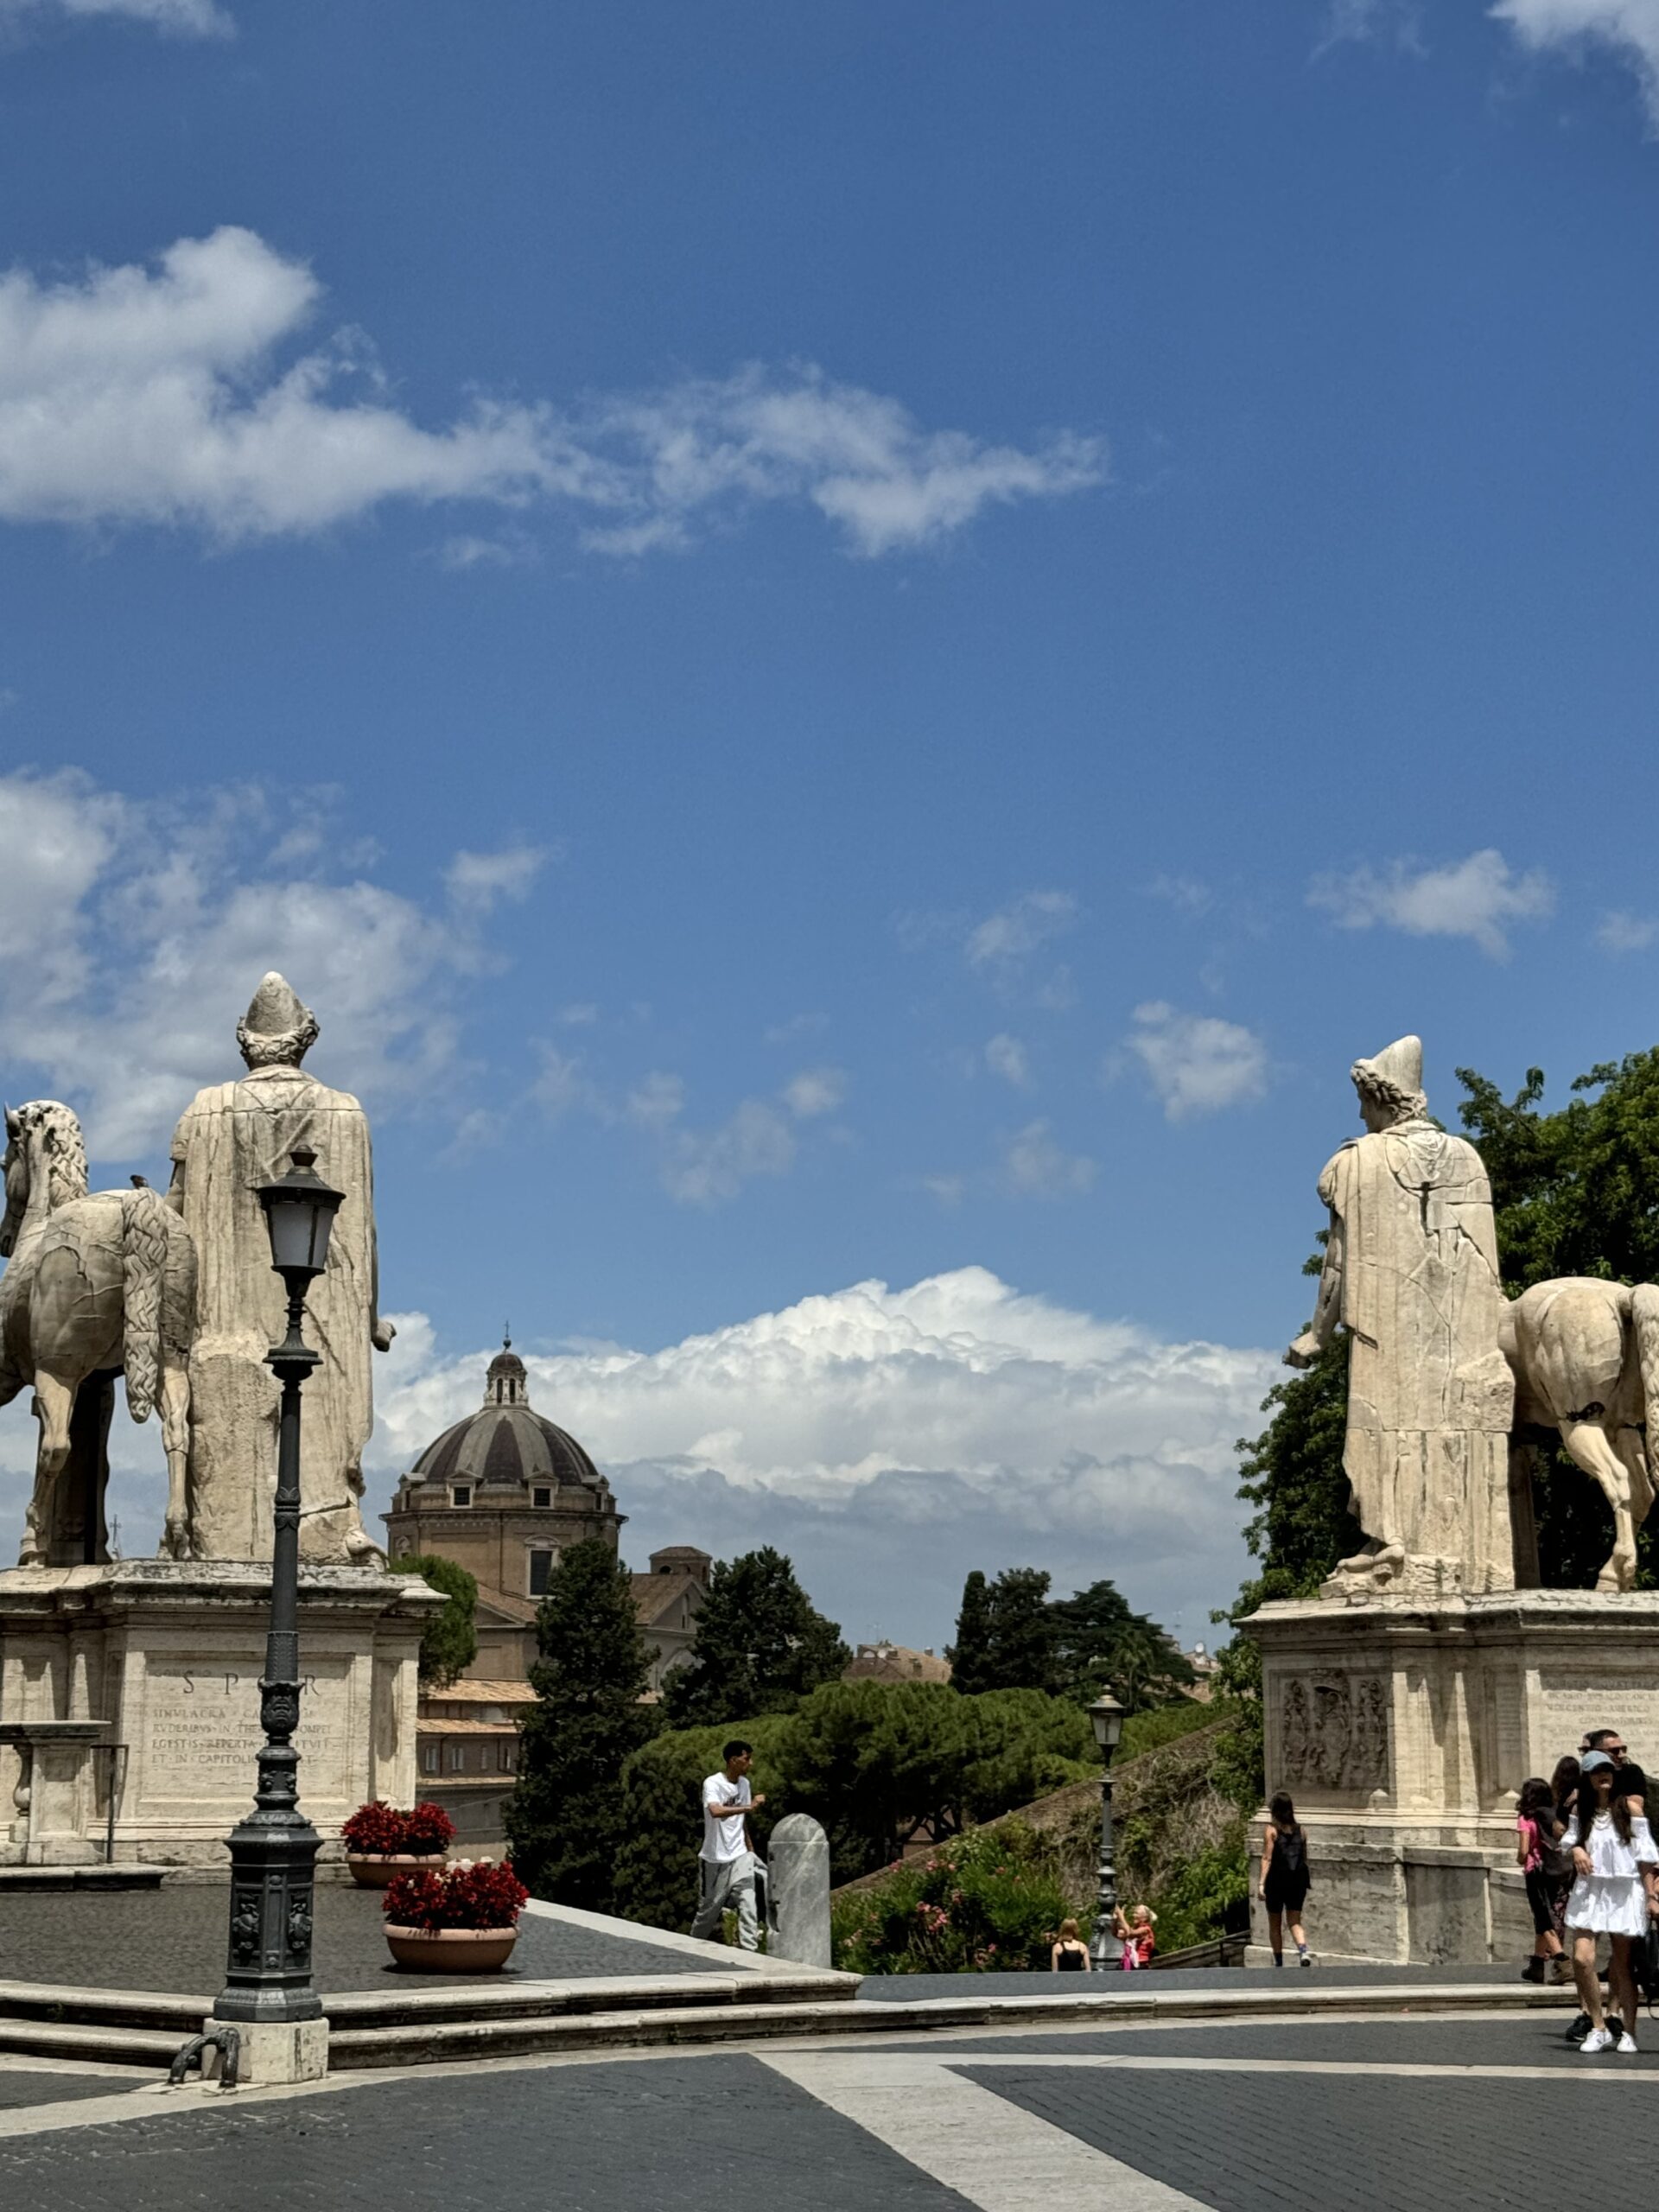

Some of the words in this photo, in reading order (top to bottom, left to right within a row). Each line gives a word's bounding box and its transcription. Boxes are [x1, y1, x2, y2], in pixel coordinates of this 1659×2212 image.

[183, 1669, 194, 1694] S
[224, 1673, 238, 1694] P
[303, 1674, 321, 1695] R
[152, 1754, 168, 1764] ET
[175, 1754, 188, 1764] IN
